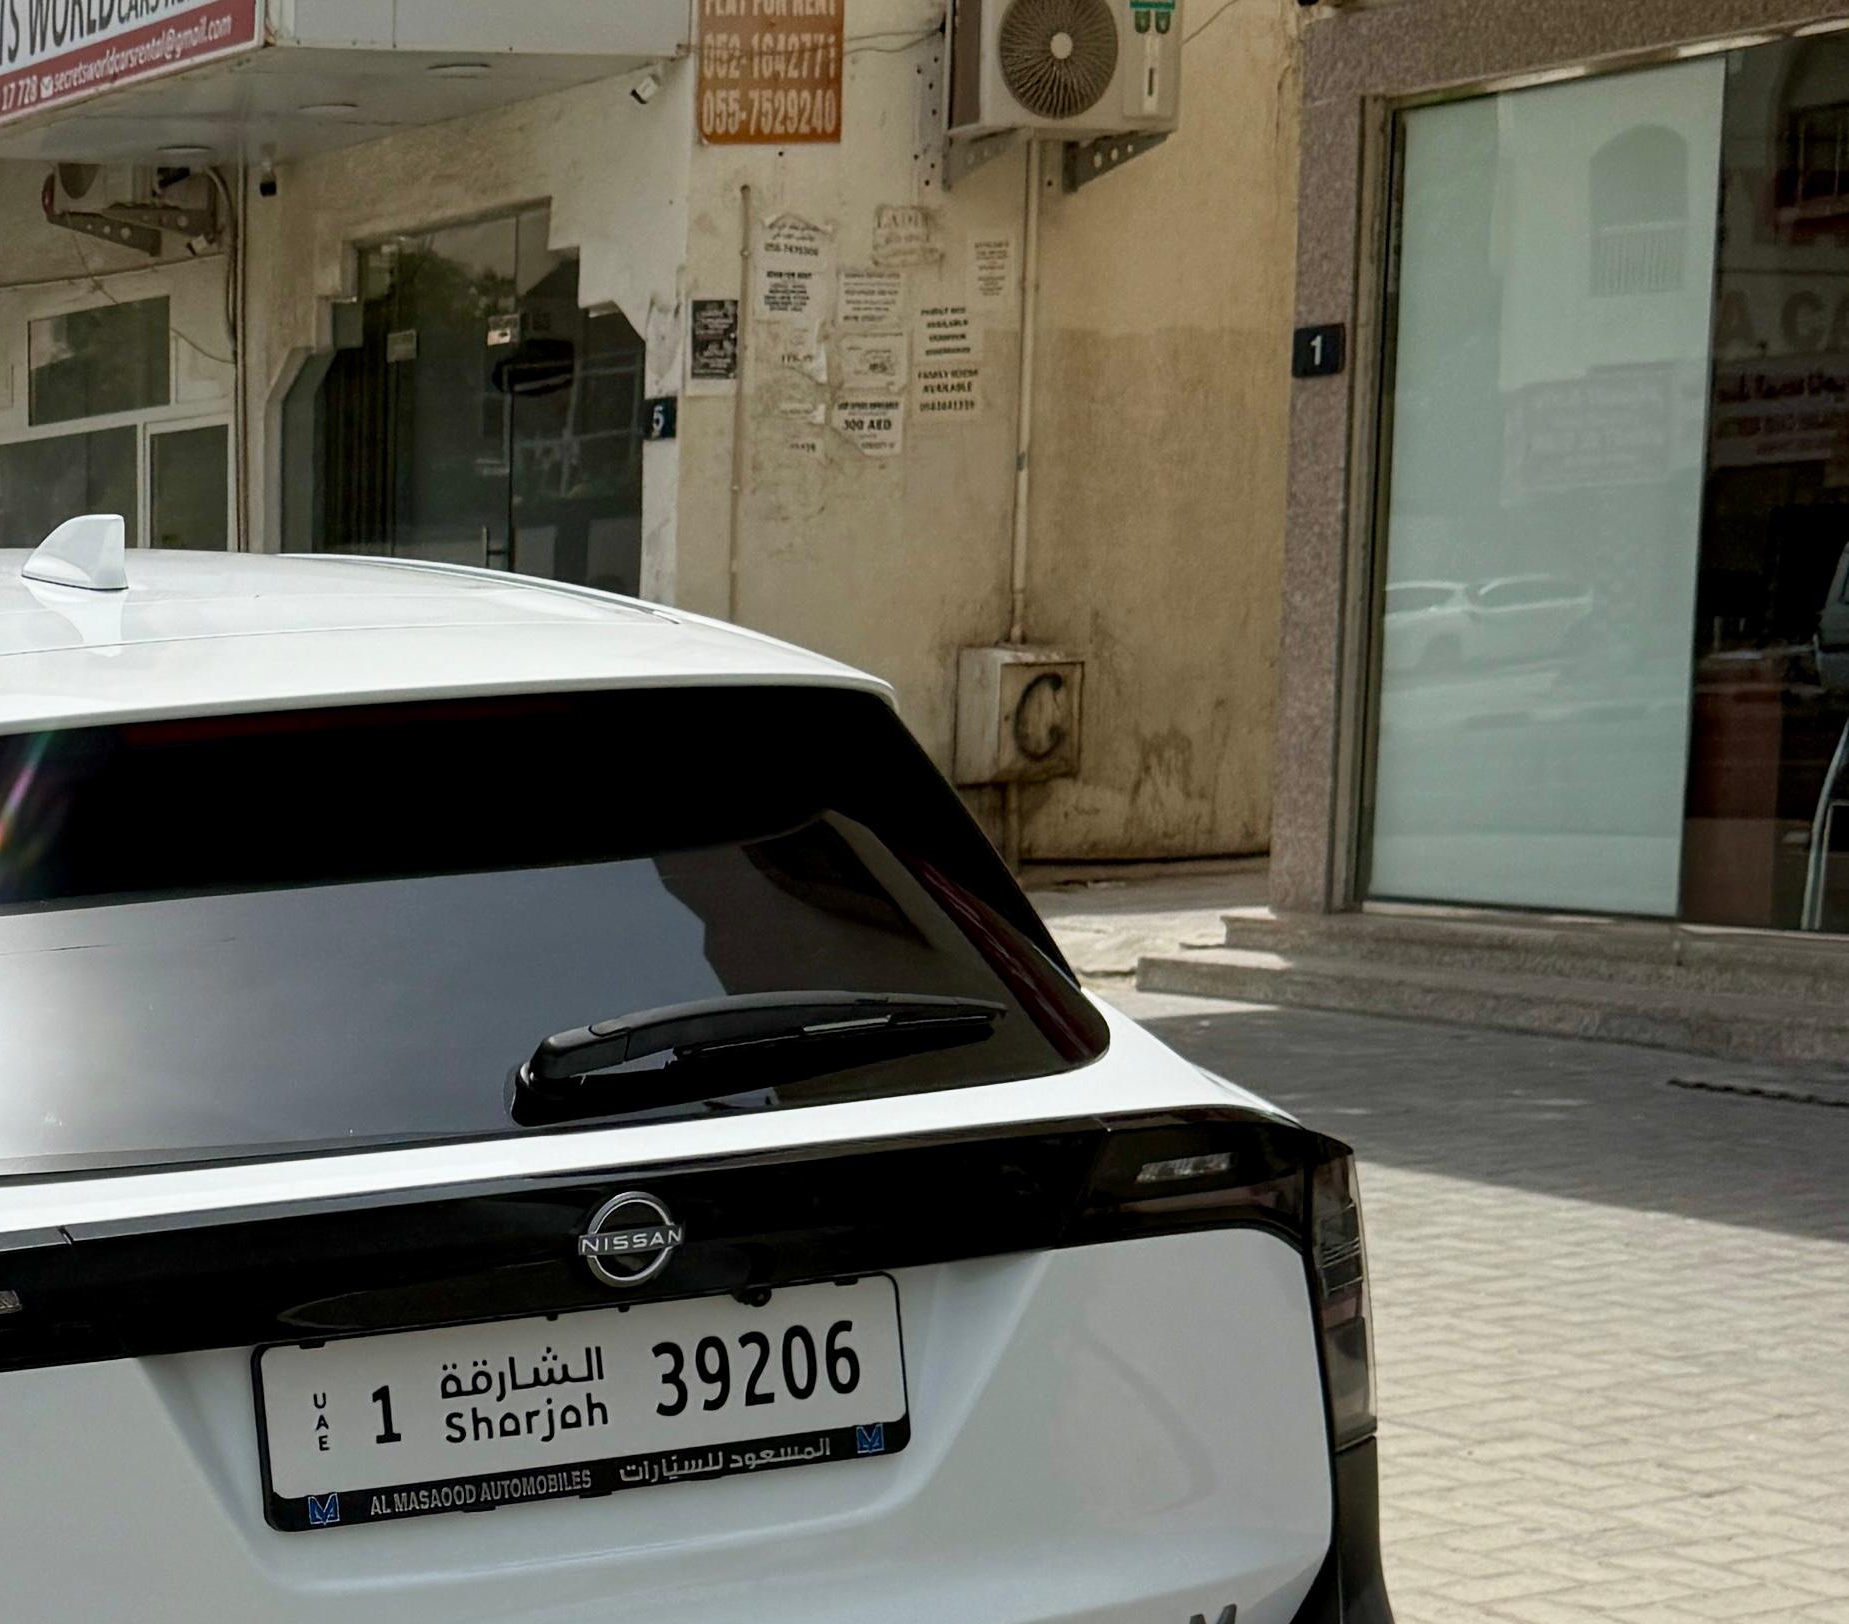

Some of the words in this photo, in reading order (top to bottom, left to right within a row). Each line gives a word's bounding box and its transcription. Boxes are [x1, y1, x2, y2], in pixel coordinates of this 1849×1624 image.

[702, 89, 836, 135] 055-7529240
[1310, 335, 1322, 365] 1
[868, 419, 892, 431] AED
[581, 1225, 683, 1254] NISSAN
[440, 1345, 606, 1401] الشارقة
[651, 1319, 862, 1418] 39206
[371, 1384, 402, 1445] 1
[444, 1392, 610, 1444] Sharjah
[728, 1437, 832, 1470] المسعود
[369, 1492, 394, 1517] AL
[393, 1482, 476, 1514] MASAOOD
[479, 1468, 593, 1504] AUTOMOBILES
